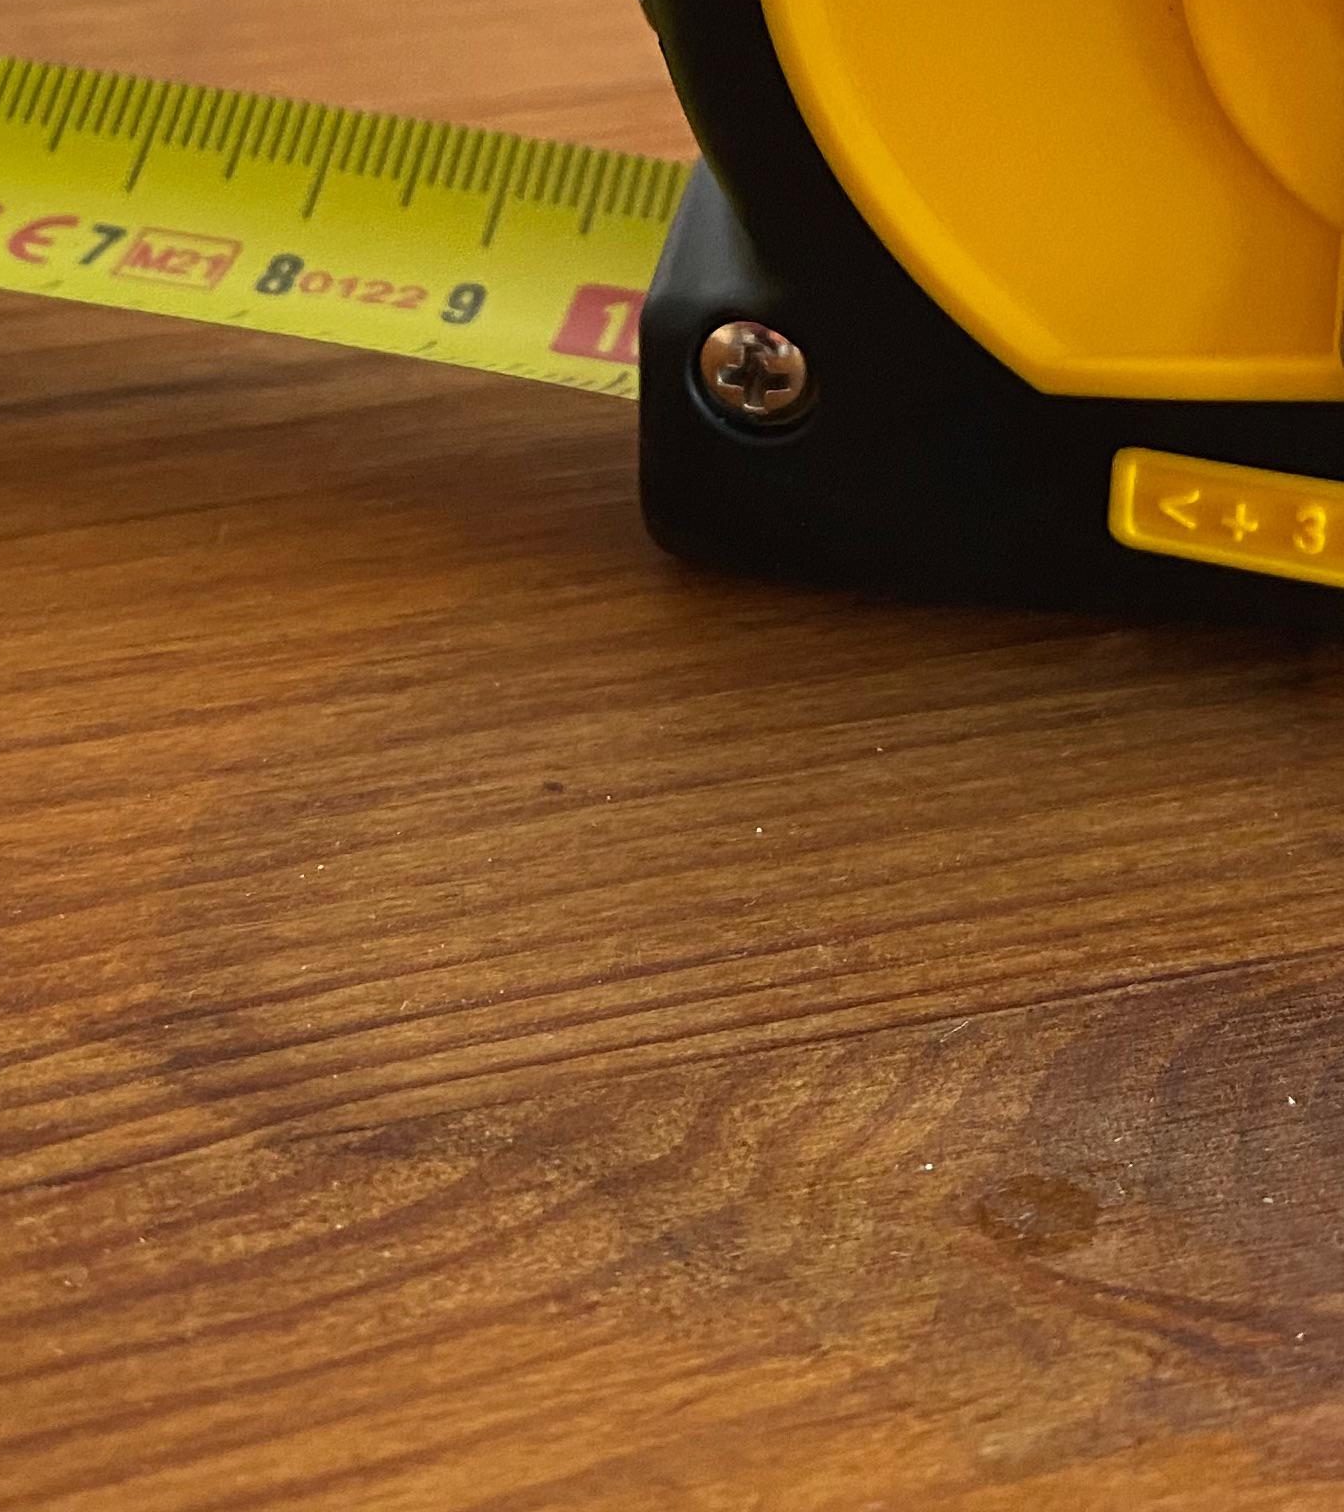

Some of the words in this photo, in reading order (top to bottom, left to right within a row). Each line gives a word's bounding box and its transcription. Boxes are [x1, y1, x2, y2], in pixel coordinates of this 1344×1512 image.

[78, 222, 127, 266] 7
[120, 238, 232, 280] M21
[254, 252, 305, 296] 8
[299, 269, 429, 311] 0122
[440, 282, 489, 325] 9
[1292, 504, 1329, 555] 3
